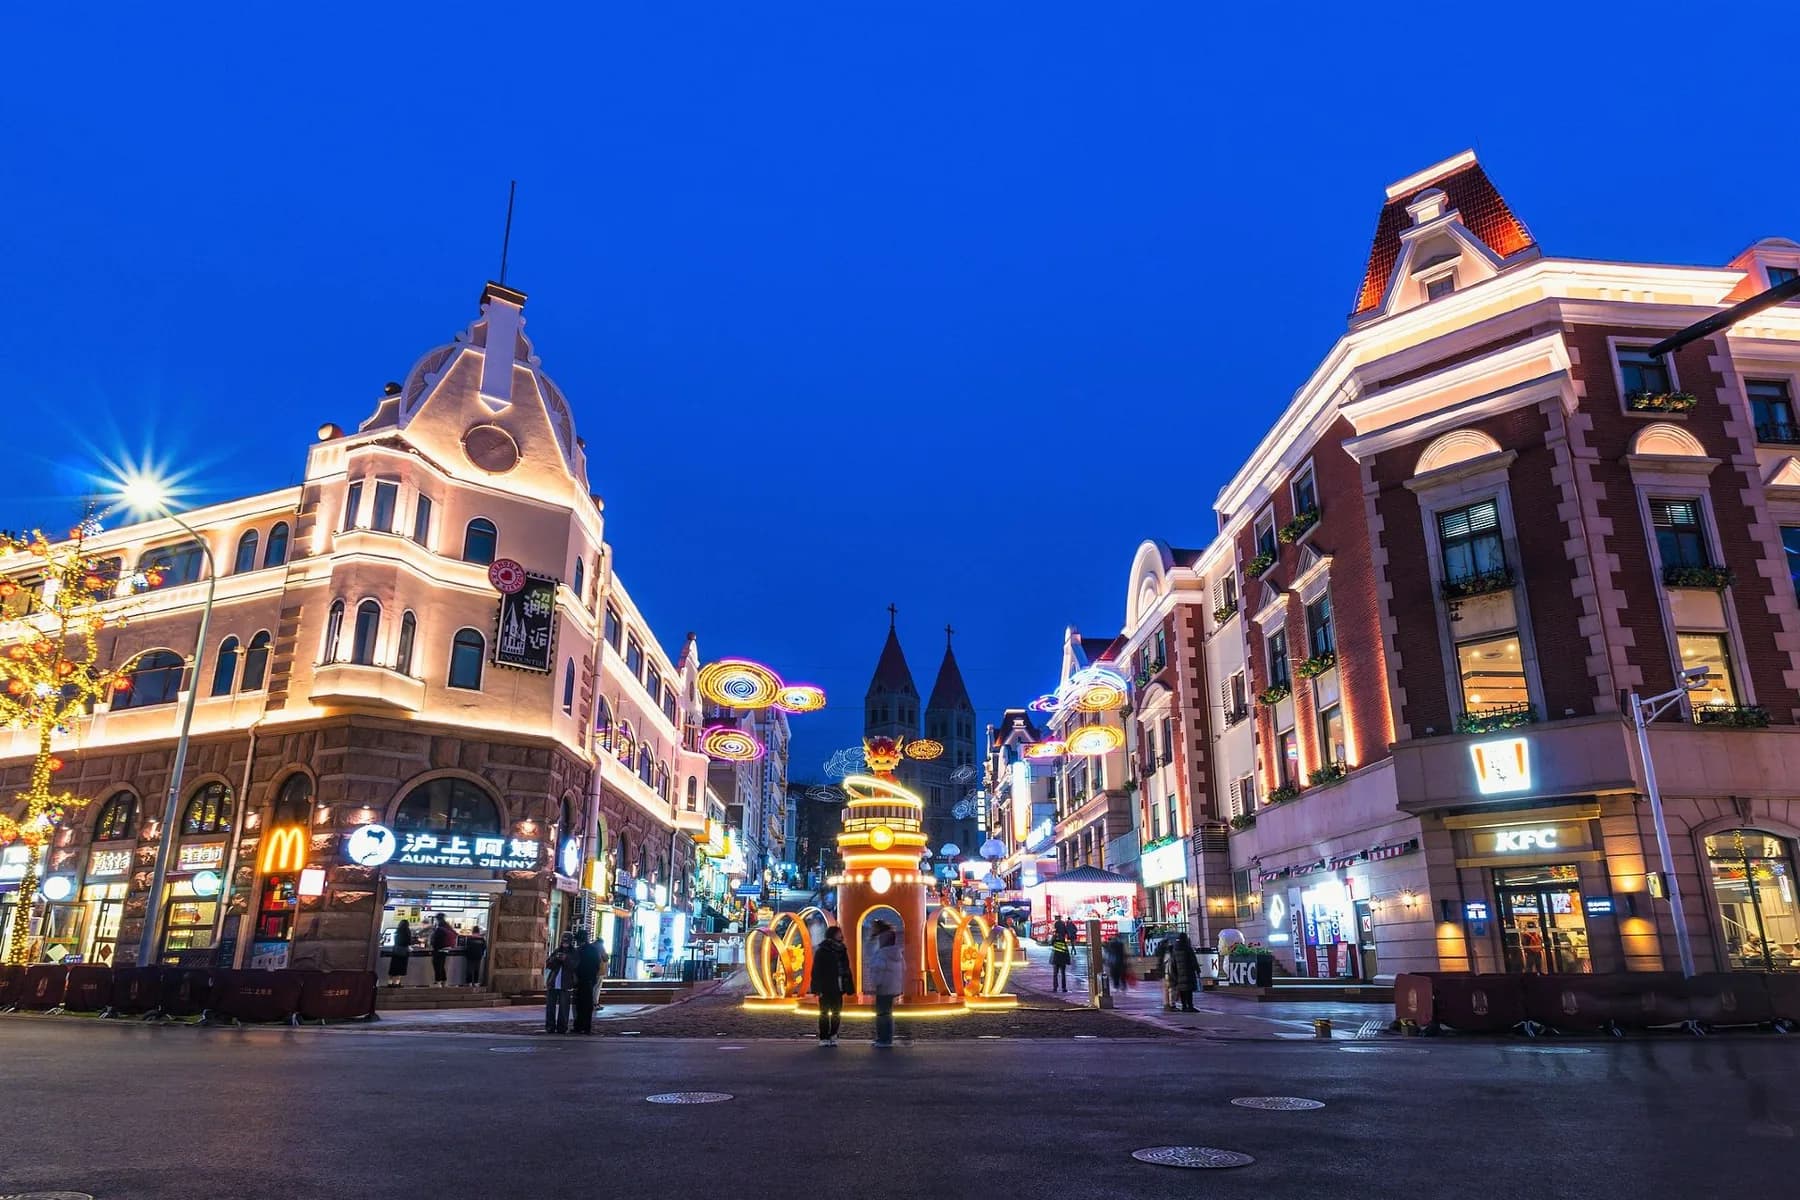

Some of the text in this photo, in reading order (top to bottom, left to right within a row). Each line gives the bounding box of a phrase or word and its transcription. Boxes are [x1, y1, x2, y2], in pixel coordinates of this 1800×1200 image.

[401, 833, 539, 859] 沪上阿姨
[1495, 829, 1557, 852] KFC
[400, 855, 537, 869] AUNTEA JENNY
[1229, 961, 1257, 985] KFC
